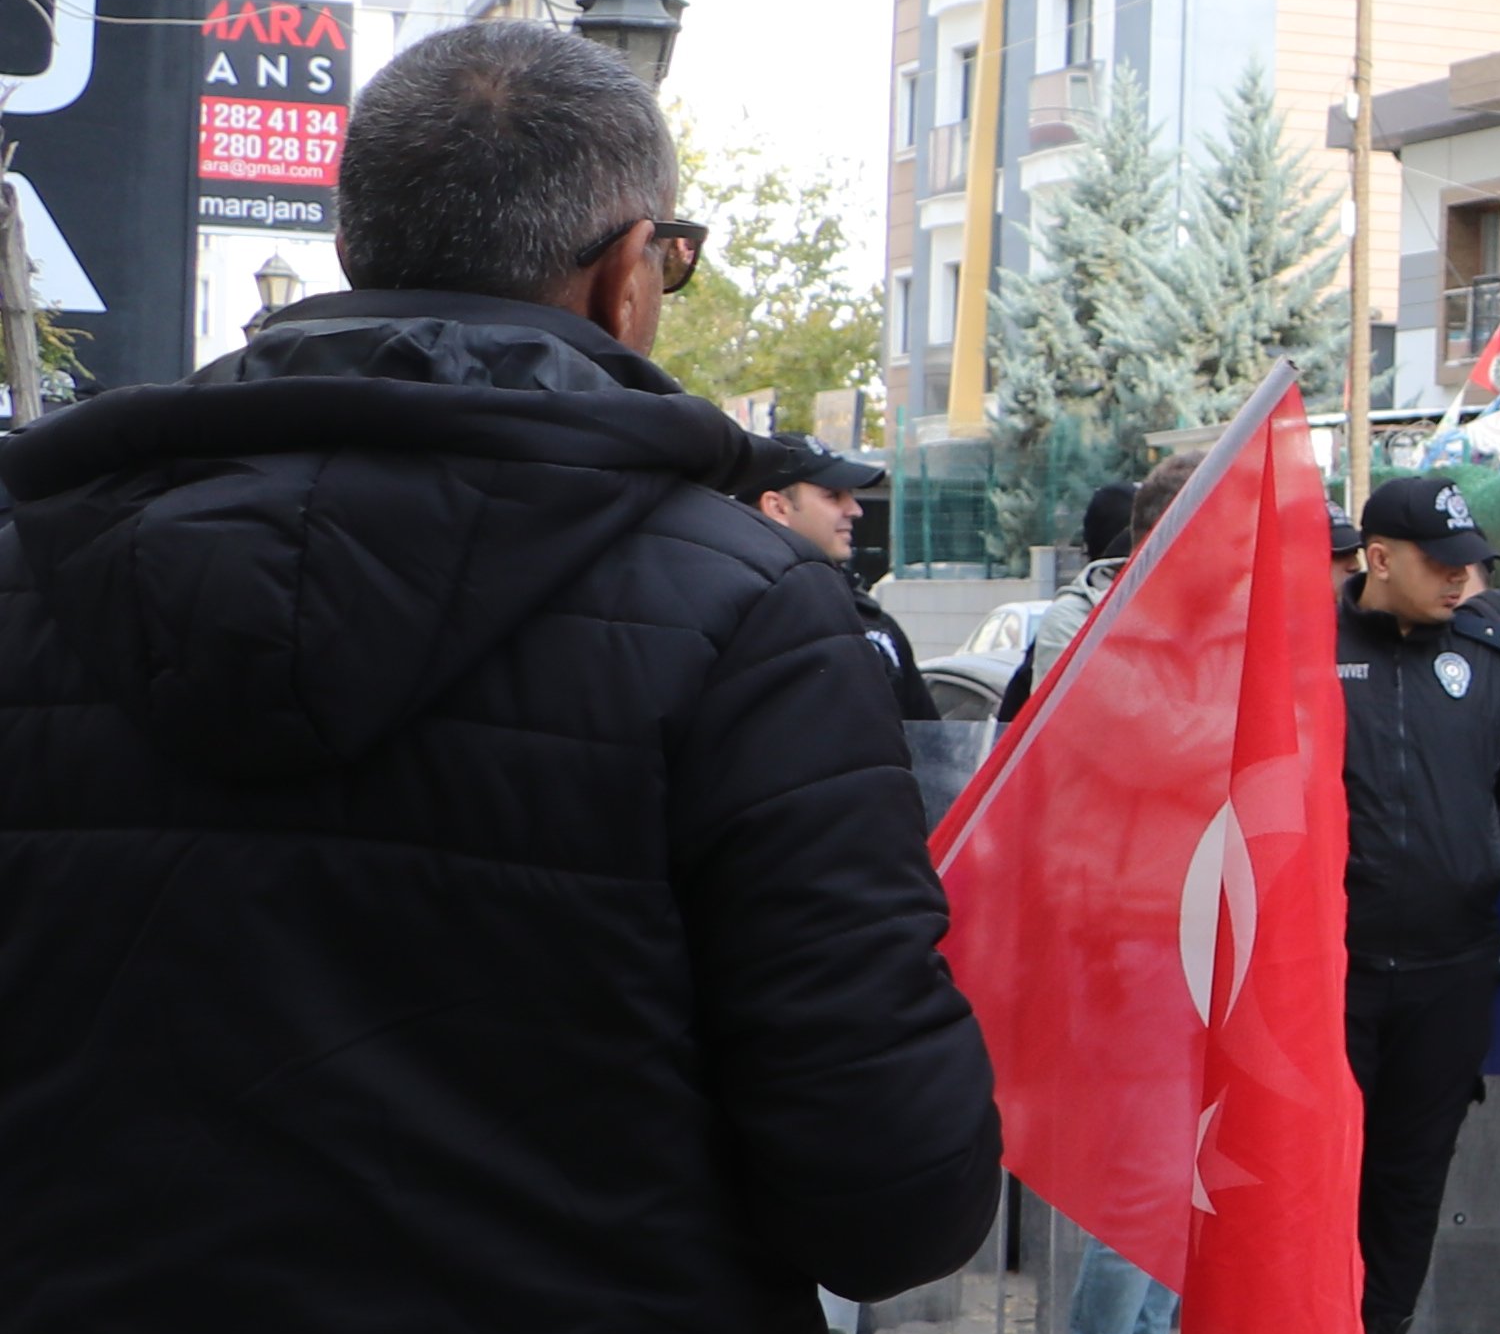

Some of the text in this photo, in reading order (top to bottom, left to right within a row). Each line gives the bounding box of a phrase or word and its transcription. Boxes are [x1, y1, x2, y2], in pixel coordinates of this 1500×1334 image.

[206, 51, 333, 94] ANS
[213, 103, 338, 135] 282 41 34
[213, 132, 338, 164] 280 28 57
[199, 195, 324, 225] marajans
